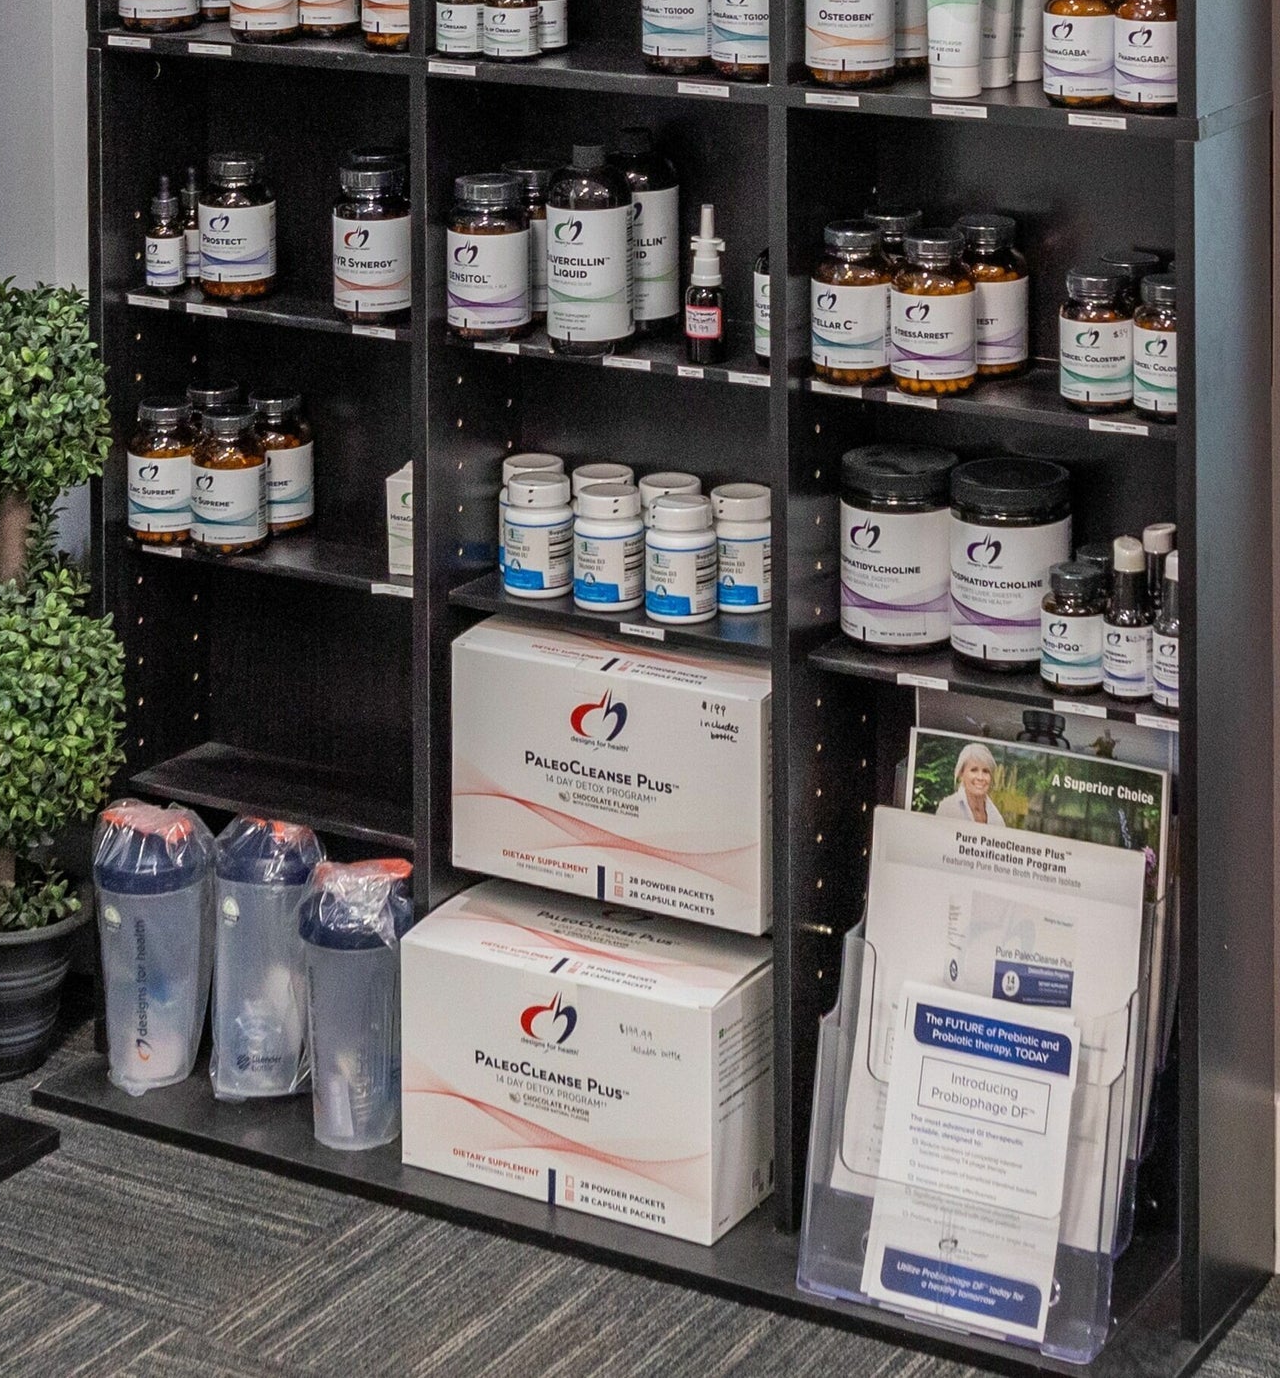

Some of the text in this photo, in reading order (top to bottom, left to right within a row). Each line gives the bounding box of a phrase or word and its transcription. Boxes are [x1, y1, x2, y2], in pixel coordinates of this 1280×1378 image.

[664, 7, 694, 15] TG1000
[700, 719, 739, 734] includes
[570, 736, 629, 752] designs for health
[545, 774, 651, 803] 14 DAY DETOX PROGRAM
[572, 792, 611, 807] CHOCOLATE
[612, 800, 639, 813] FLAVOR
[1051, 774, 1154, 805] A Superior Choice
[956, 831, 1065, 861] Pure PaleoCleanse Plus
[958, 845, 1067, 874] Detoxification Program
[502, 849, 535, 862] DIETARY
[537, 855, 589, 874] SUPPLEMENT
[629, 875, 714, 902] 28 POWDER PACKETS
[629, 889, 715, 916] 28 CAPSULE PACKETS
[1006, 974, 1015, 986] 14
[926, 1012, 1060, 1051] The FUTURE of Prebiotic and
[932, 1029, 1049, 1063] Probiotic therapy, TODAY
[495, 1074, 602, 1108] 14 DAY DETOX PROGRAM
[951, 1071, 1019, 1100] Introducing
[931, 1086, 1028, 1118] Probiophage DF
[453, 1148, 486, 1163] DIETARY
[487, 1156, 540, 1177] SUPPLEMENT
[580, 1180, 666, 1210] 28 POWDER PACKETS
[580, 1194, 666, 1224] 28 CAPSULE PACKETS
